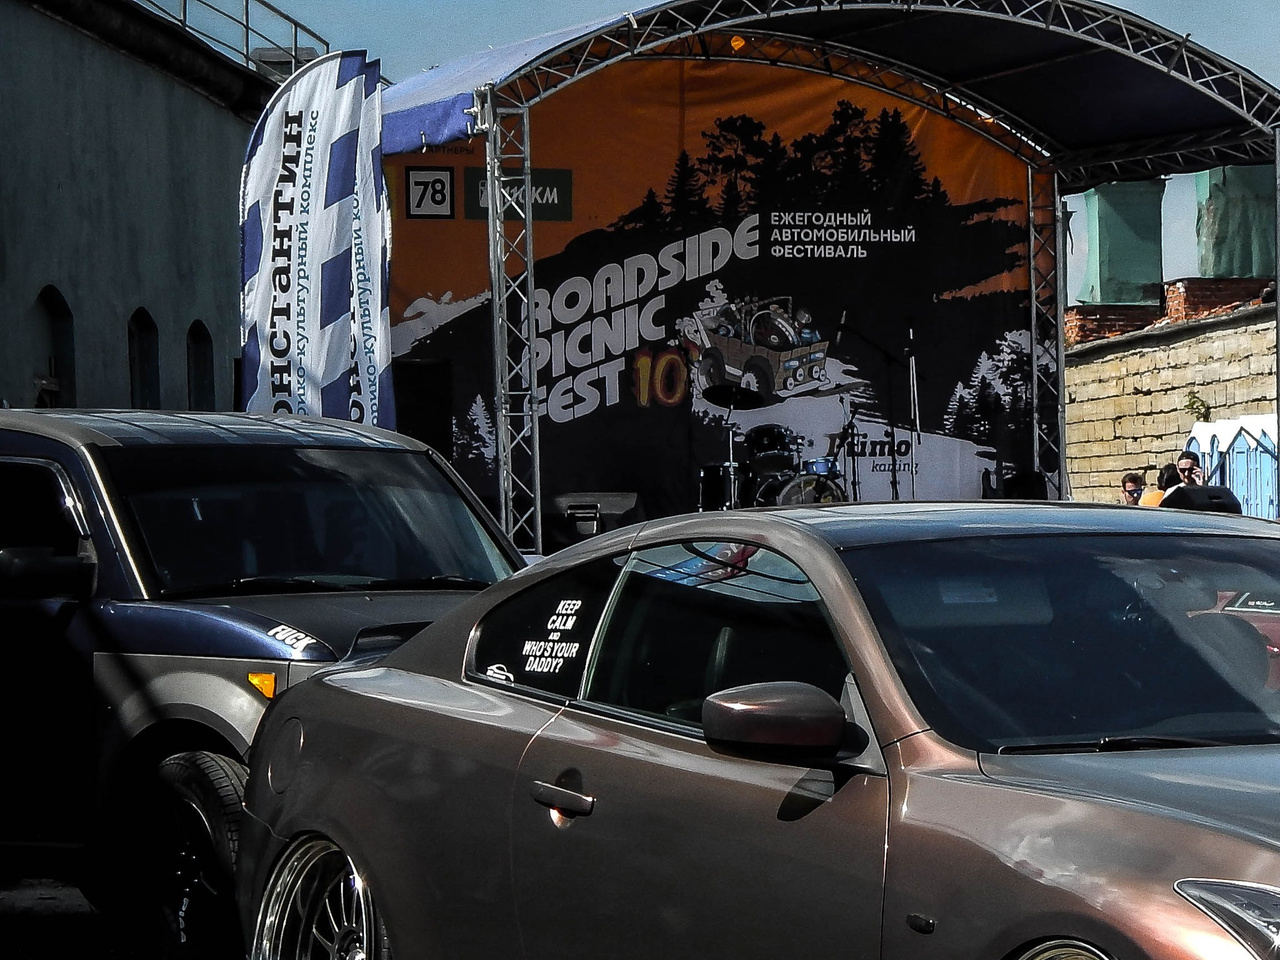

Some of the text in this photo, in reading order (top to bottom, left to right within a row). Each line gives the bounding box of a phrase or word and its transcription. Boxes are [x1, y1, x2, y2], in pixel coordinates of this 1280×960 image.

[421, 145, 475, 155] АРТНЕРЫ
[300, 109, 319, 216] комплекс
[413, 178, 448, 209] 78
[770, 208, 872, 227] ЕЖЕГОДНЫЙ
[770, 226, 916, 242] АВТОМОБИЛЬНЫЙ
[770, 245, 868, 258] ФЕСТИВАЛЬ
[521, 214, 760, 339] ROADSIDE
[521, 295, 665, 388] PICNIC
[522, 353, 690, 437] FEST 10
[871, 460, 919, 475] karing
[556, 600, 582, 614] KEEP
[547, 615, 577, 630] CALM
[267, 624, 317, 652] FUCK
[522, 640, 580, 658] WHO'S YOUR
[525, 656, 564, 673] DADDY?
